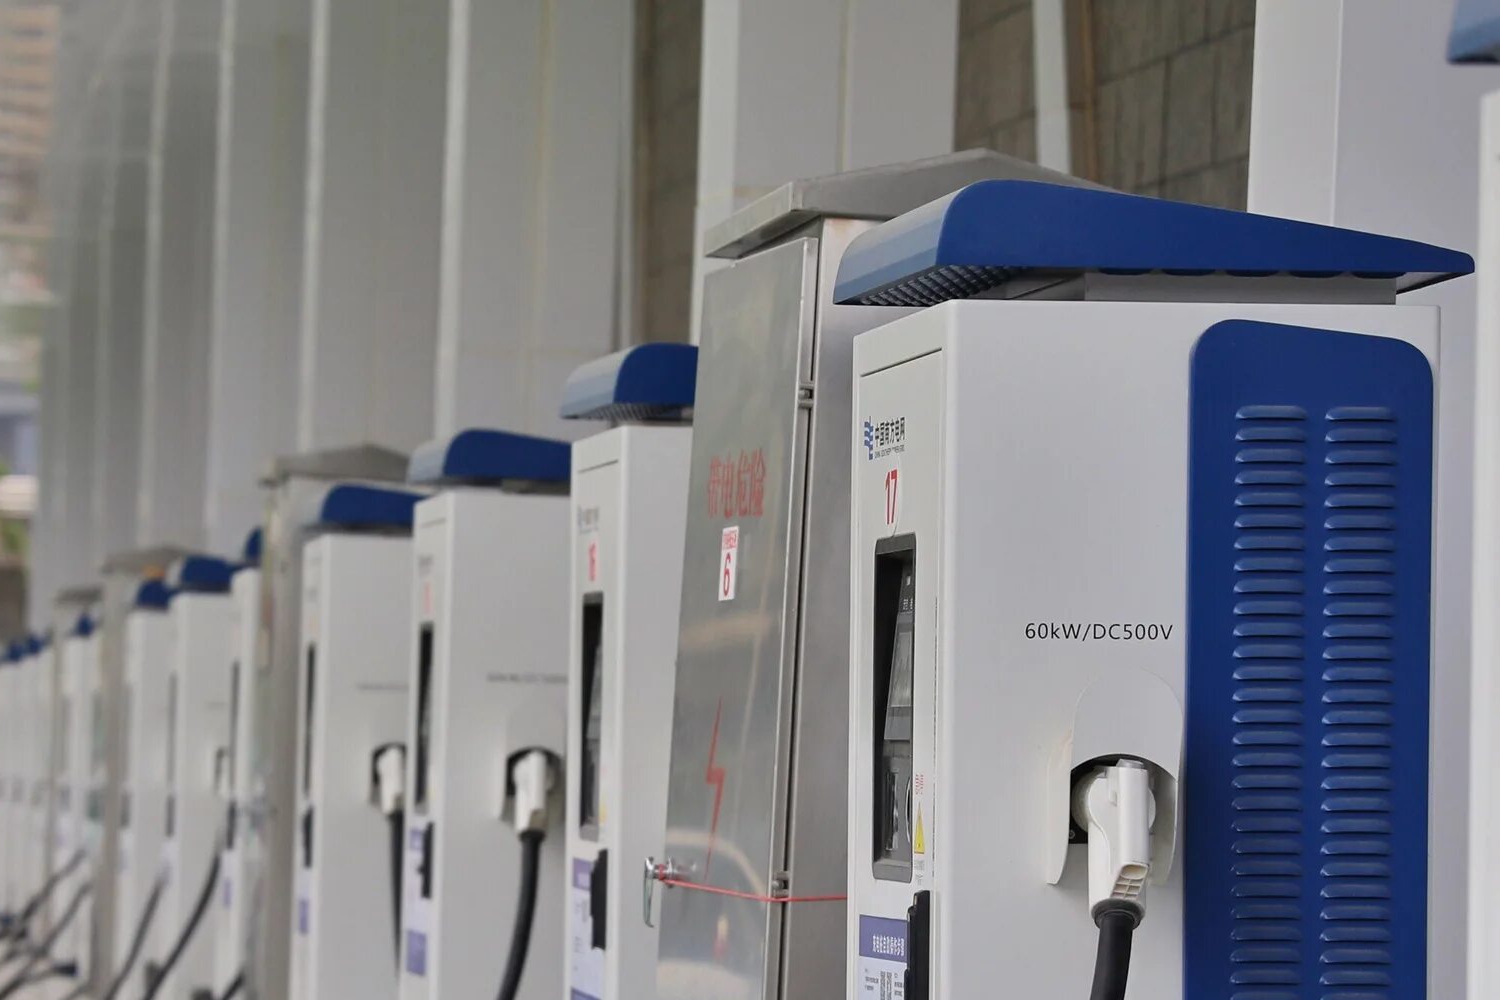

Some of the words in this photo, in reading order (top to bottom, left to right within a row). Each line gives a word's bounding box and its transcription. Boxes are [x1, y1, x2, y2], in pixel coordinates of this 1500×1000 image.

[875, 416, 906, 447] 中国南方电网
[884, 468, 899, 526] 17
[723, 552, 732, 597] 6
[1025, 622, 1173, 642] 60kW/DC500V
